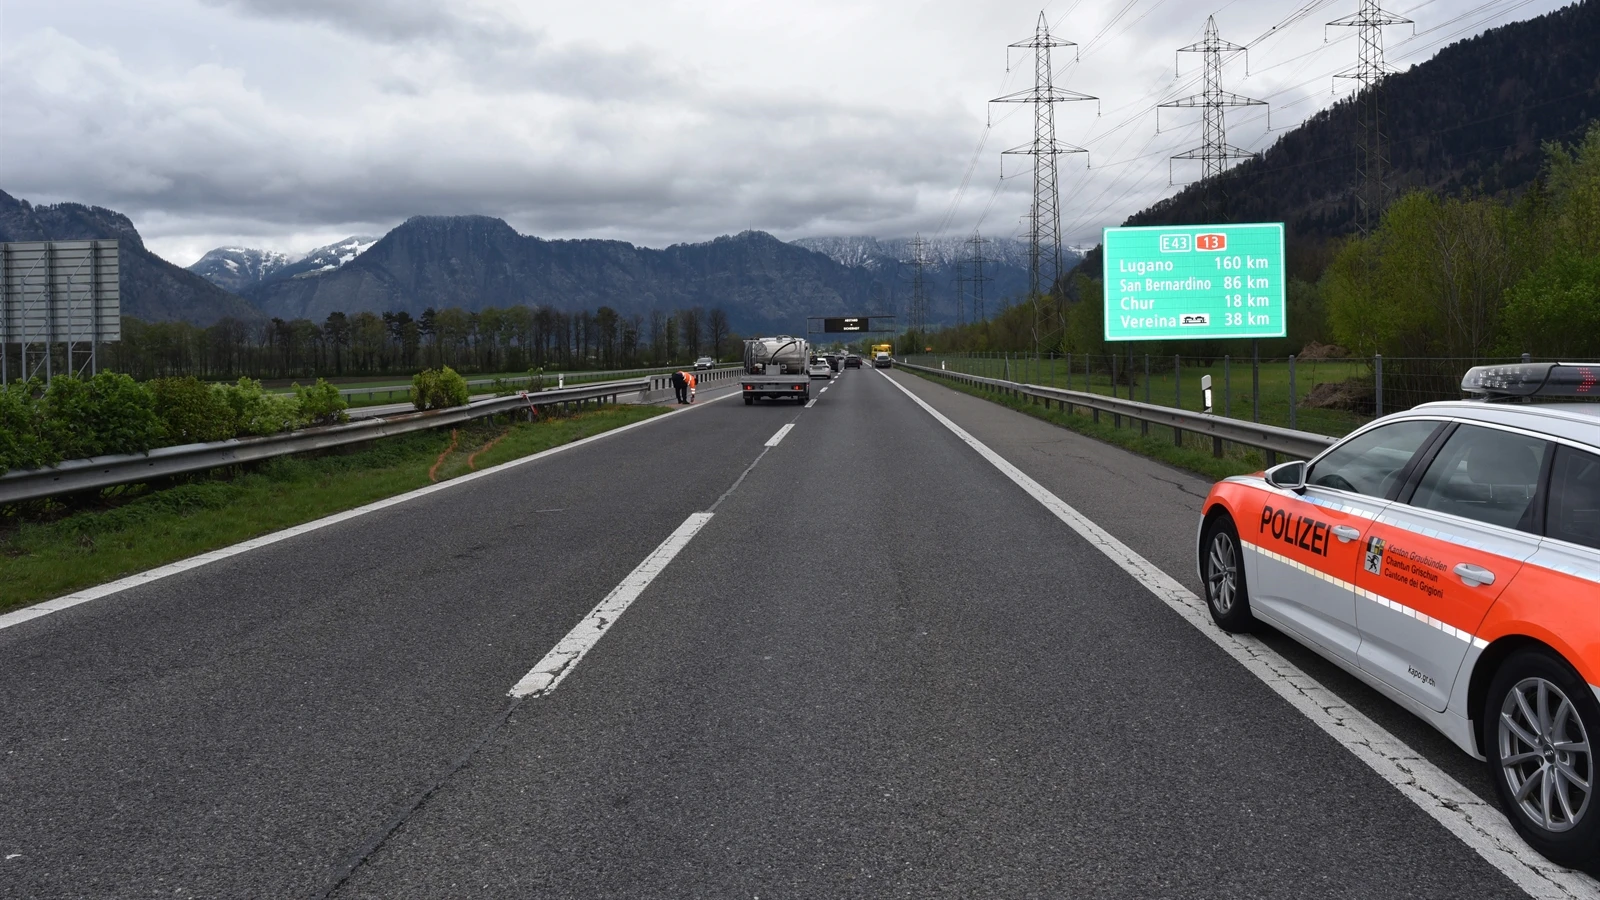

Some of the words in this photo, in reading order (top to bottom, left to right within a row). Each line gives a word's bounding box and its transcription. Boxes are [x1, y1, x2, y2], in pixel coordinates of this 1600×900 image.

[1203, 236, 1218, 248] 13
[1120, 259, 1174, 275] Lugano
[1215, 256, 1241, 270] 160
[1247, 255, 1268, 269] km
[1120, 278, 1142, 292] San
[1146, 276, 1212, 291] Bernardino
[1224, 276, 1242, 290] 86
[1247, 275, 1268, 288] km
[1120, 296, 1154, 310] Chur
[1224, 294, 1242, 308] 18
[1248, 294, 1269, 307] km
[1120, 314, 1176, 328] Vereina
[1224, 312, 1242, 326] 38
[1248, 312, 1270, 325] km
[1260, 505, 1332, 558] POLIZEI
[1386, 556, 1410, 572] Chantun
[1411, 564, 1438, 582] Grischun
[1388, 544, 1409, 558] Kanton
[1410, 551, 1448, 572] Graubünden
[1384, 568, 1408, 584] Cantone
[1409, 578, 1418, 588] dei
[1420, 581, 1444, 598] Grigioni
[1408, 664, 1436, 688] kapo.gr.ch
